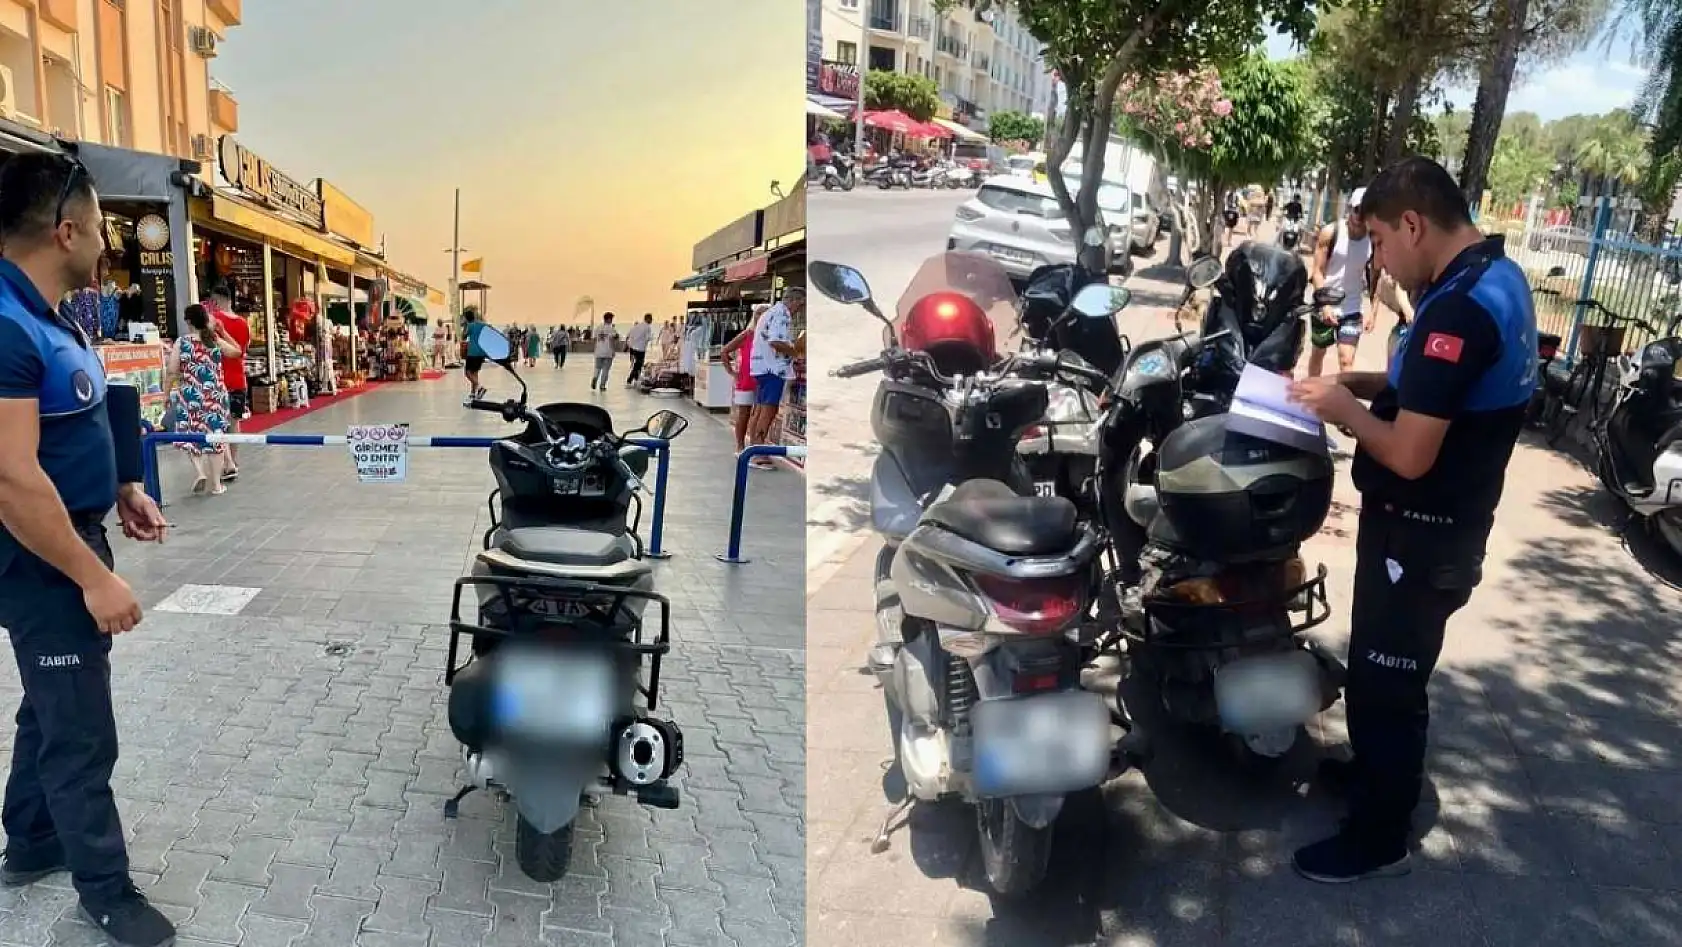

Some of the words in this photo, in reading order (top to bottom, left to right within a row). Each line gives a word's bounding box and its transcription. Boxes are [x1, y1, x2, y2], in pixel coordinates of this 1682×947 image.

[140, 252, 174, 267] CALIS
[370, 453, 400, 462] ENTRY
[1402, 509, 1454, 525] ZABITA
[39, 654, 80, 667] ZABITA
[1367, 649, 1418, 671] ZABITA
